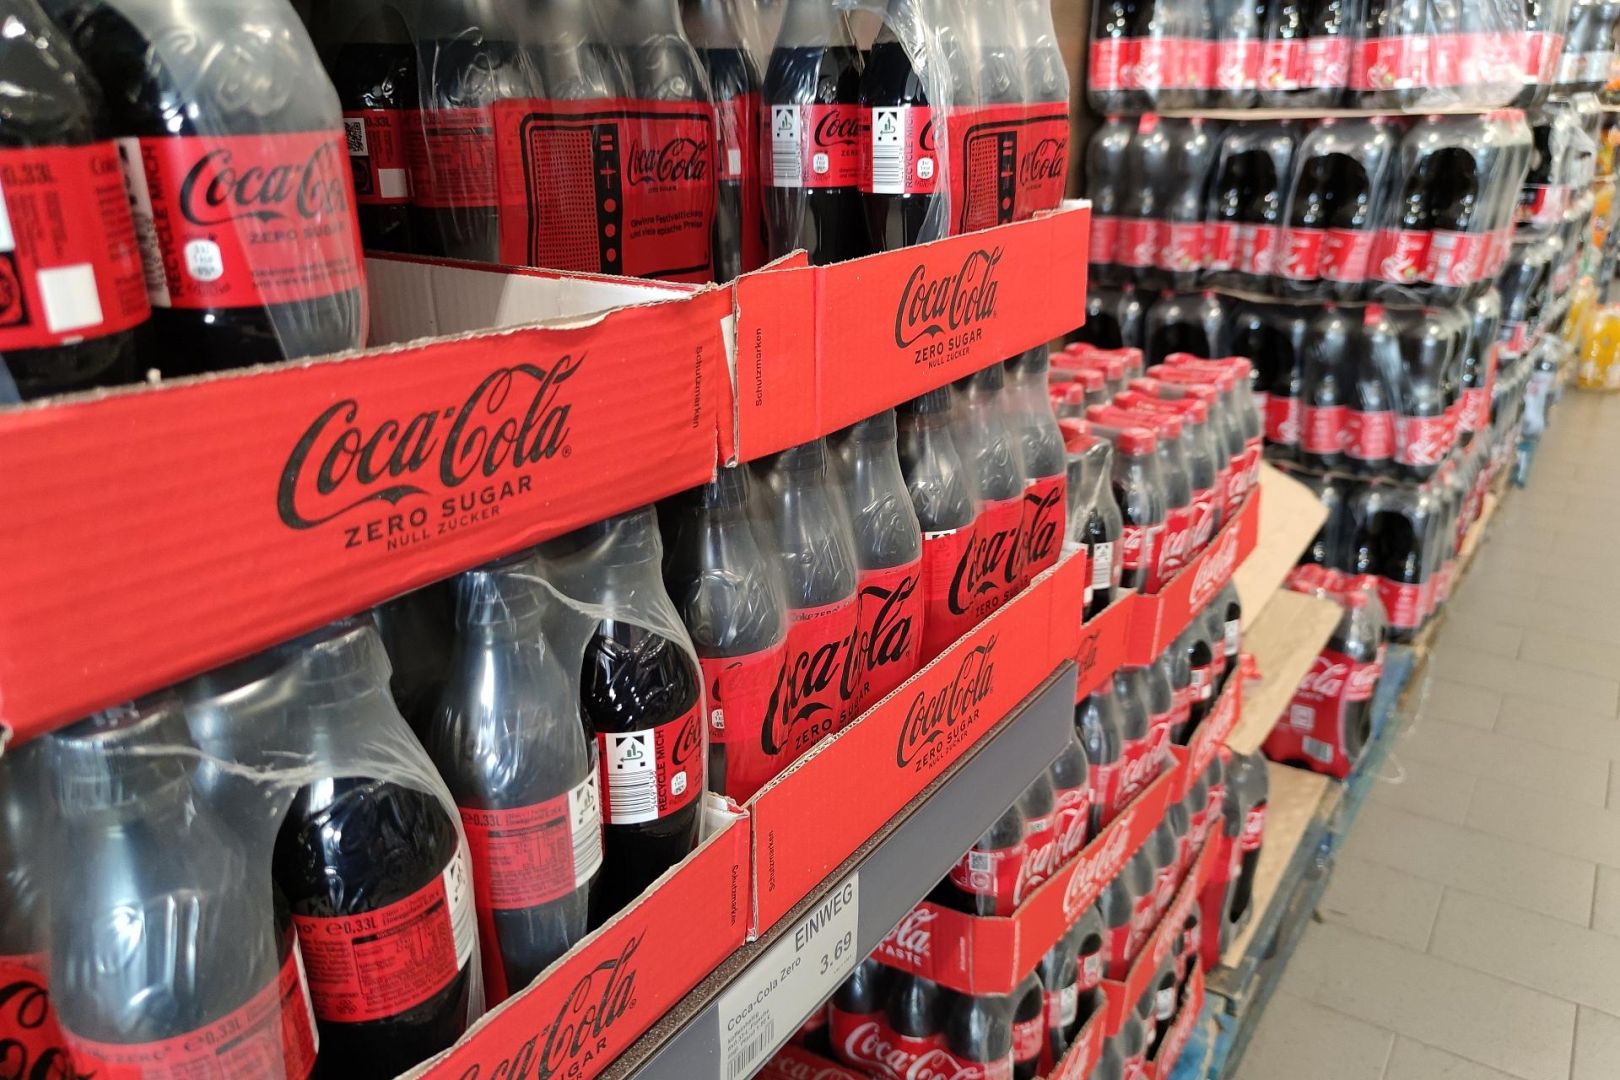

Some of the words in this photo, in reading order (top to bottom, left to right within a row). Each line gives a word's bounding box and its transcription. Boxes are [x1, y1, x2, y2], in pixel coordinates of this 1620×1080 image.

[905, 142, 913, 188] RECYCLE
[895, 246, 1005, 349] Coca-Cola
[915, 342, 944, 364] ZERO
[948, 328, 982, 352] SUGAR
[928, 358, 944, 369] NULL
[947, 348, 970, 362] ZUCKER
[277, 350, 588, 530] Coca-Cola
[344, 507, 428, 549] ZERO
[442, 475, 533, 518] SUGAR
[386, 530, 431, 552] NULL
[437, 505, 501, 536] ZUCKER
[897, 632, 999, 768] Coca-Cola
[655, 729, 666, 760] MICH
[795, 718, 833, 749] ZERO
[915, 741, 943, 772] ZERO
[947, 708, 980, 743] SUGAR
[657, 761, 668, 812] RECYCLE
[731, 864, 739, 927] Schutzmarken
[795, 883, 853, 952] EINWEG
[820, 931, 852, 975] 3.69
[727, 978, 778, 1031] Coca-Cola
[780, 957, 801, 981] Zero
